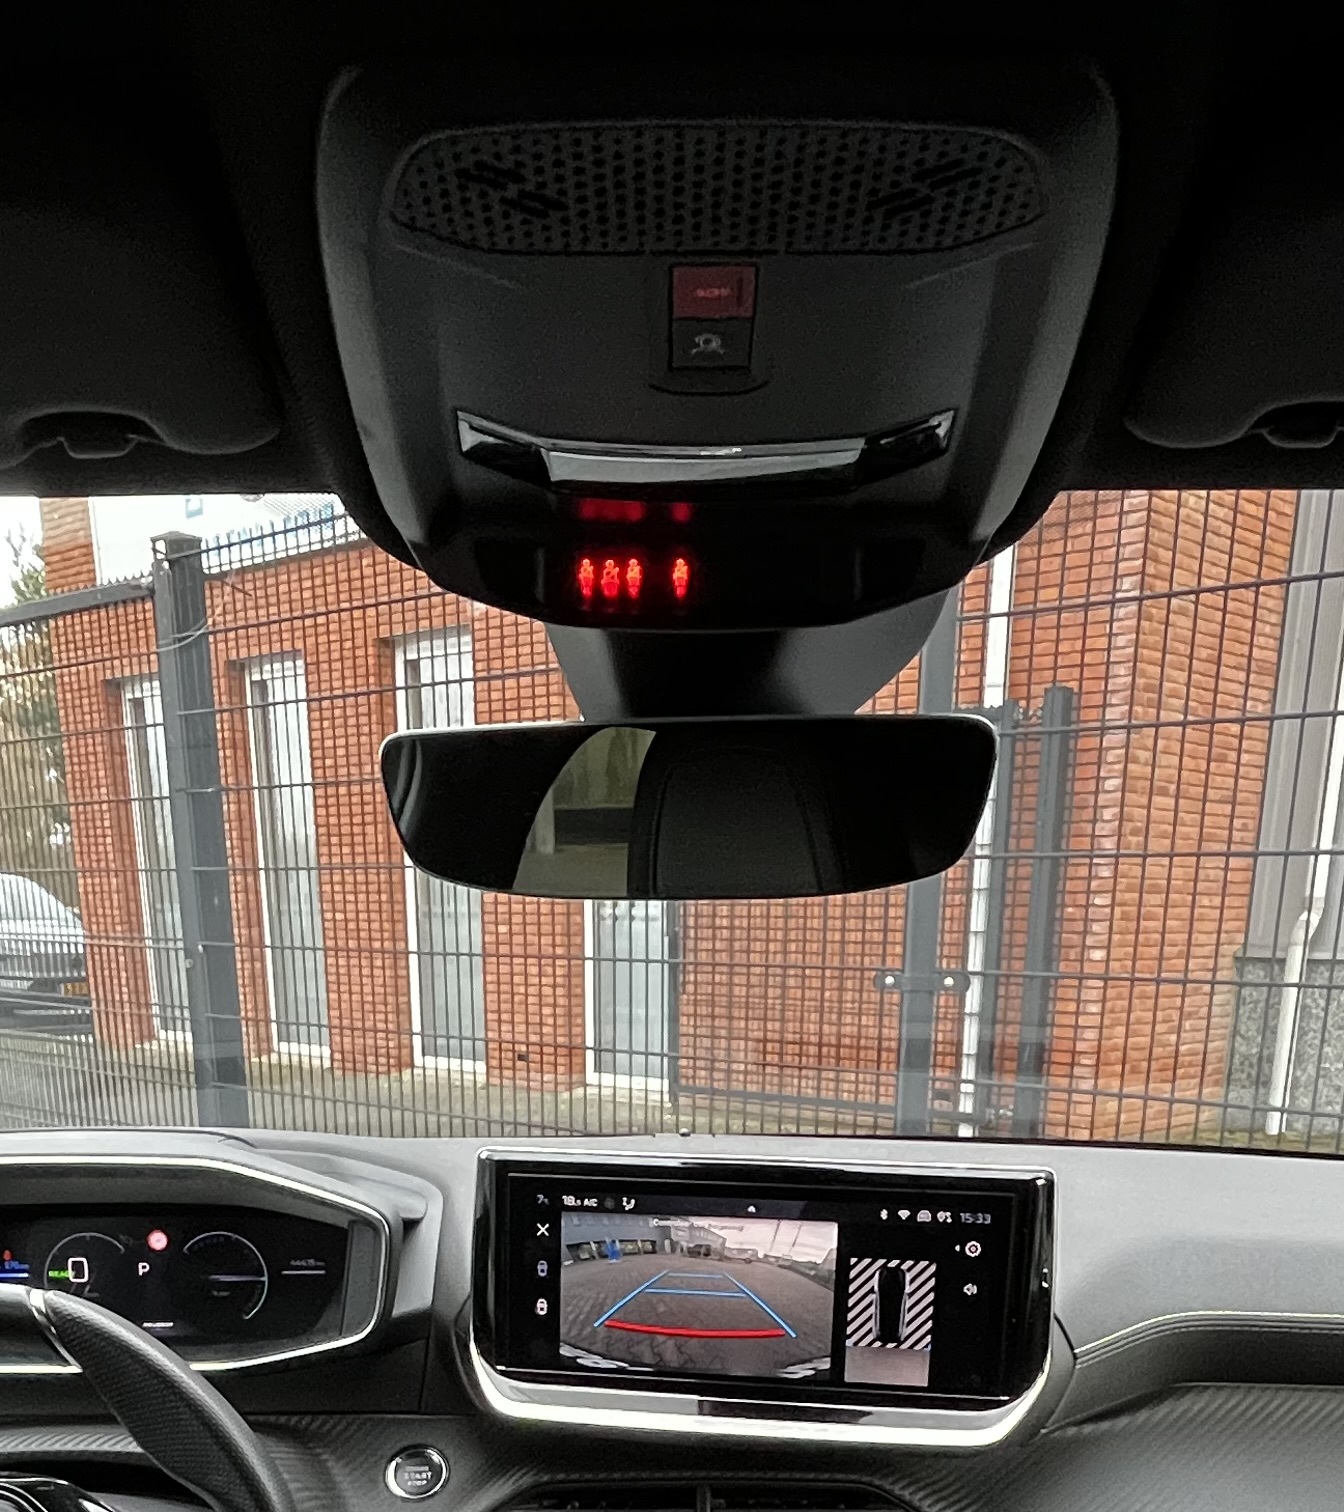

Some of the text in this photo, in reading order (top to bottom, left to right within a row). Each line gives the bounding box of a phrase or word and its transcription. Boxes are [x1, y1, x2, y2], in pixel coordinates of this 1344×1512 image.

[960, 1213, 991, 1224] 15:33
[138, 1262, 150, 1275] P
[404, 1472, 432, 1480] START
